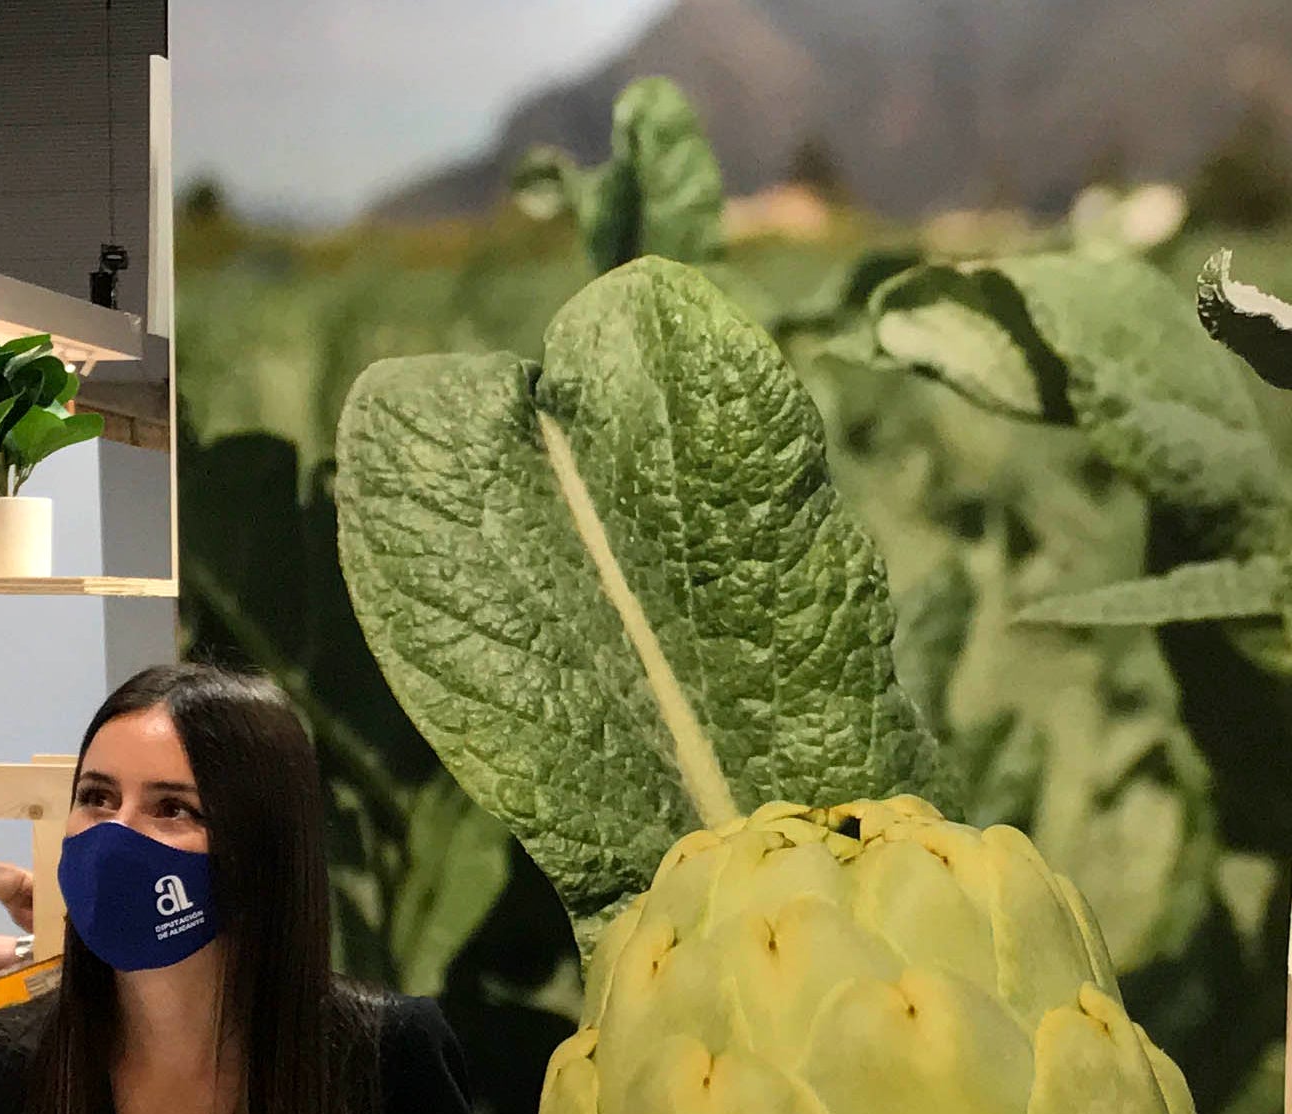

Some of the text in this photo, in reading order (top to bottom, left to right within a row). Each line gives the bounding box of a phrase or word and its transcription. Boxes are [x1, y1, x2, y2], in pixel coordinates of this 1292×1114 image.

[155, 910, 204, 933] DIPUTACIÓN
[157, 916, 205, 941] DE ALICANTE
